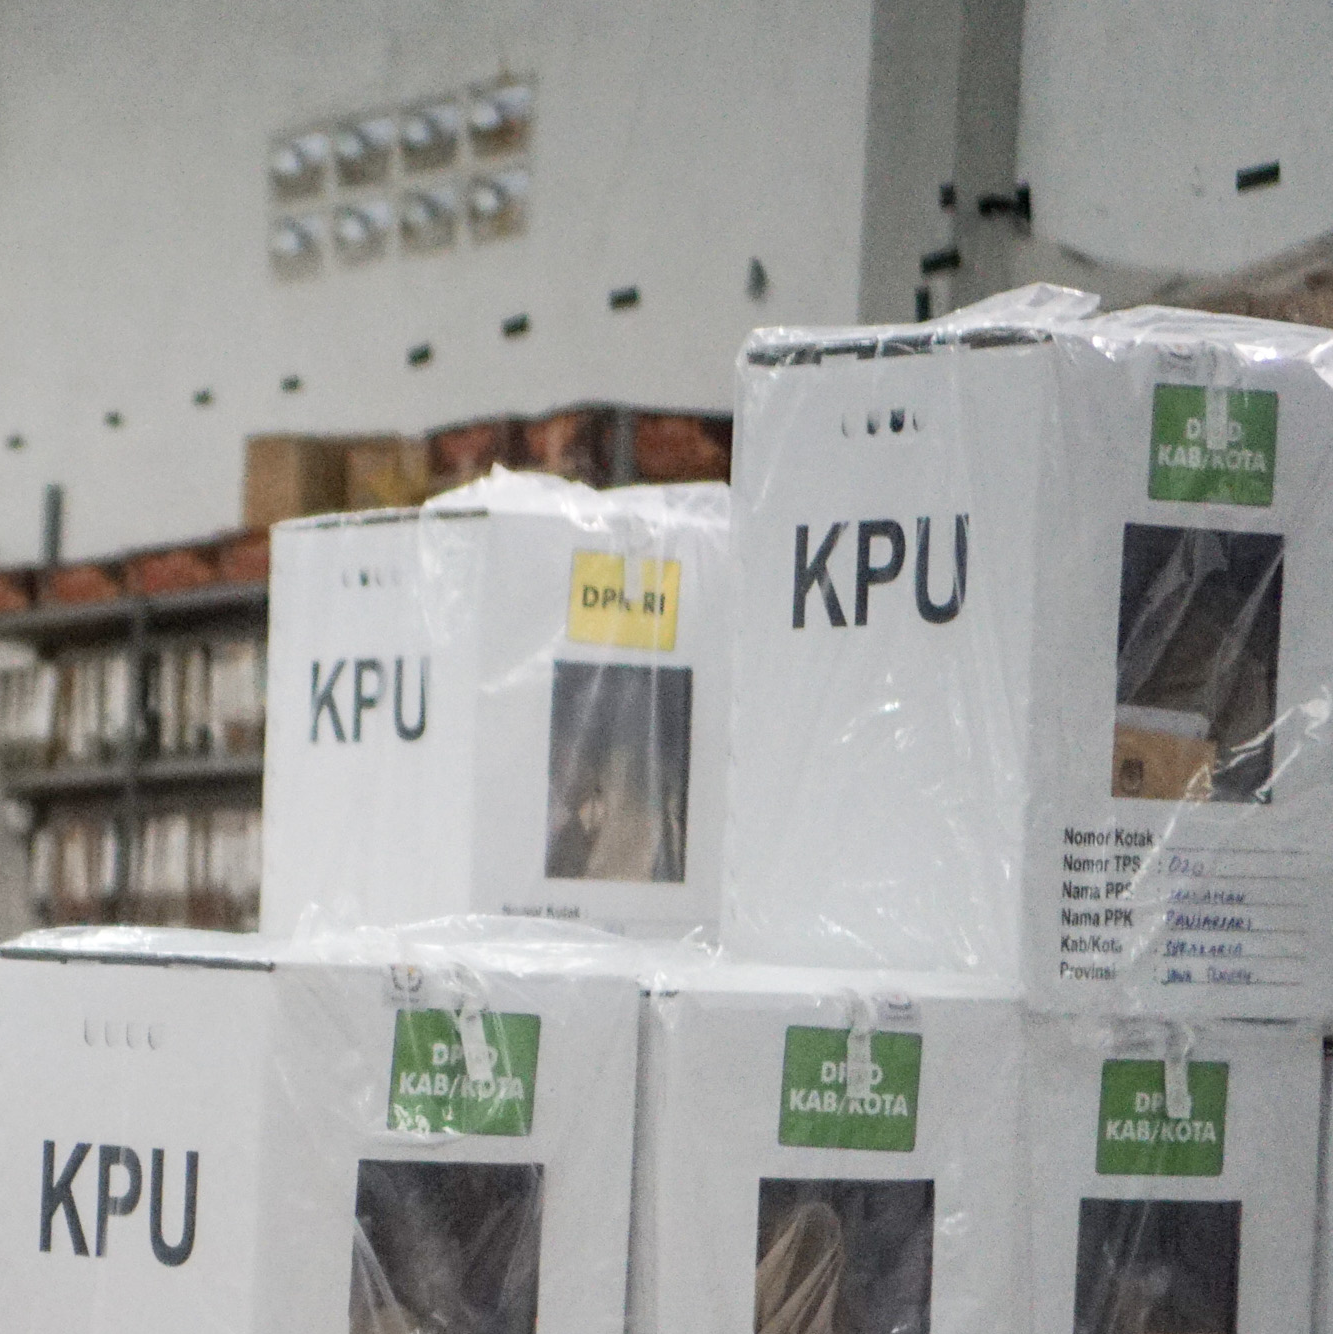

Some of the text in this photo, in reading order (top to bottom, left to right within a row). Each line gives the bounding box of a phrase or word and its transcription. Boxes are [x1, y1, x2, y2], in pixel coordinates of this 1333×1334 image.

[1186, 416, 1243, 441] DD
[1157, 443, 1267, 473] KAB/KOTA
[792, 514, 971, 630] KPU
[643, 590, 666, 615] RI
[309, 655, 431, 744] KPU
[1063, 827, 1155, 847] Nomor Kotak
[1063, 854, 1141, 872] Nomor TPS
[1062, 881, 1100, 900] Nama
[1061, 908, 1133, 928] Nama PPK
[1060, 935, 1122, 953] Kab/Kota
[1060, 961, 1116, 980] Provinsi
[431, 1042, 499, 1066] DPD
[399, 1071, 525, 1101] KAB/KOTA
[789, 1087, 909, 1117] KAB/KOTA
[1105, 1118, 1217, 1144] KAB/KOTA
[39, 1139, 199, 1267] KPU
